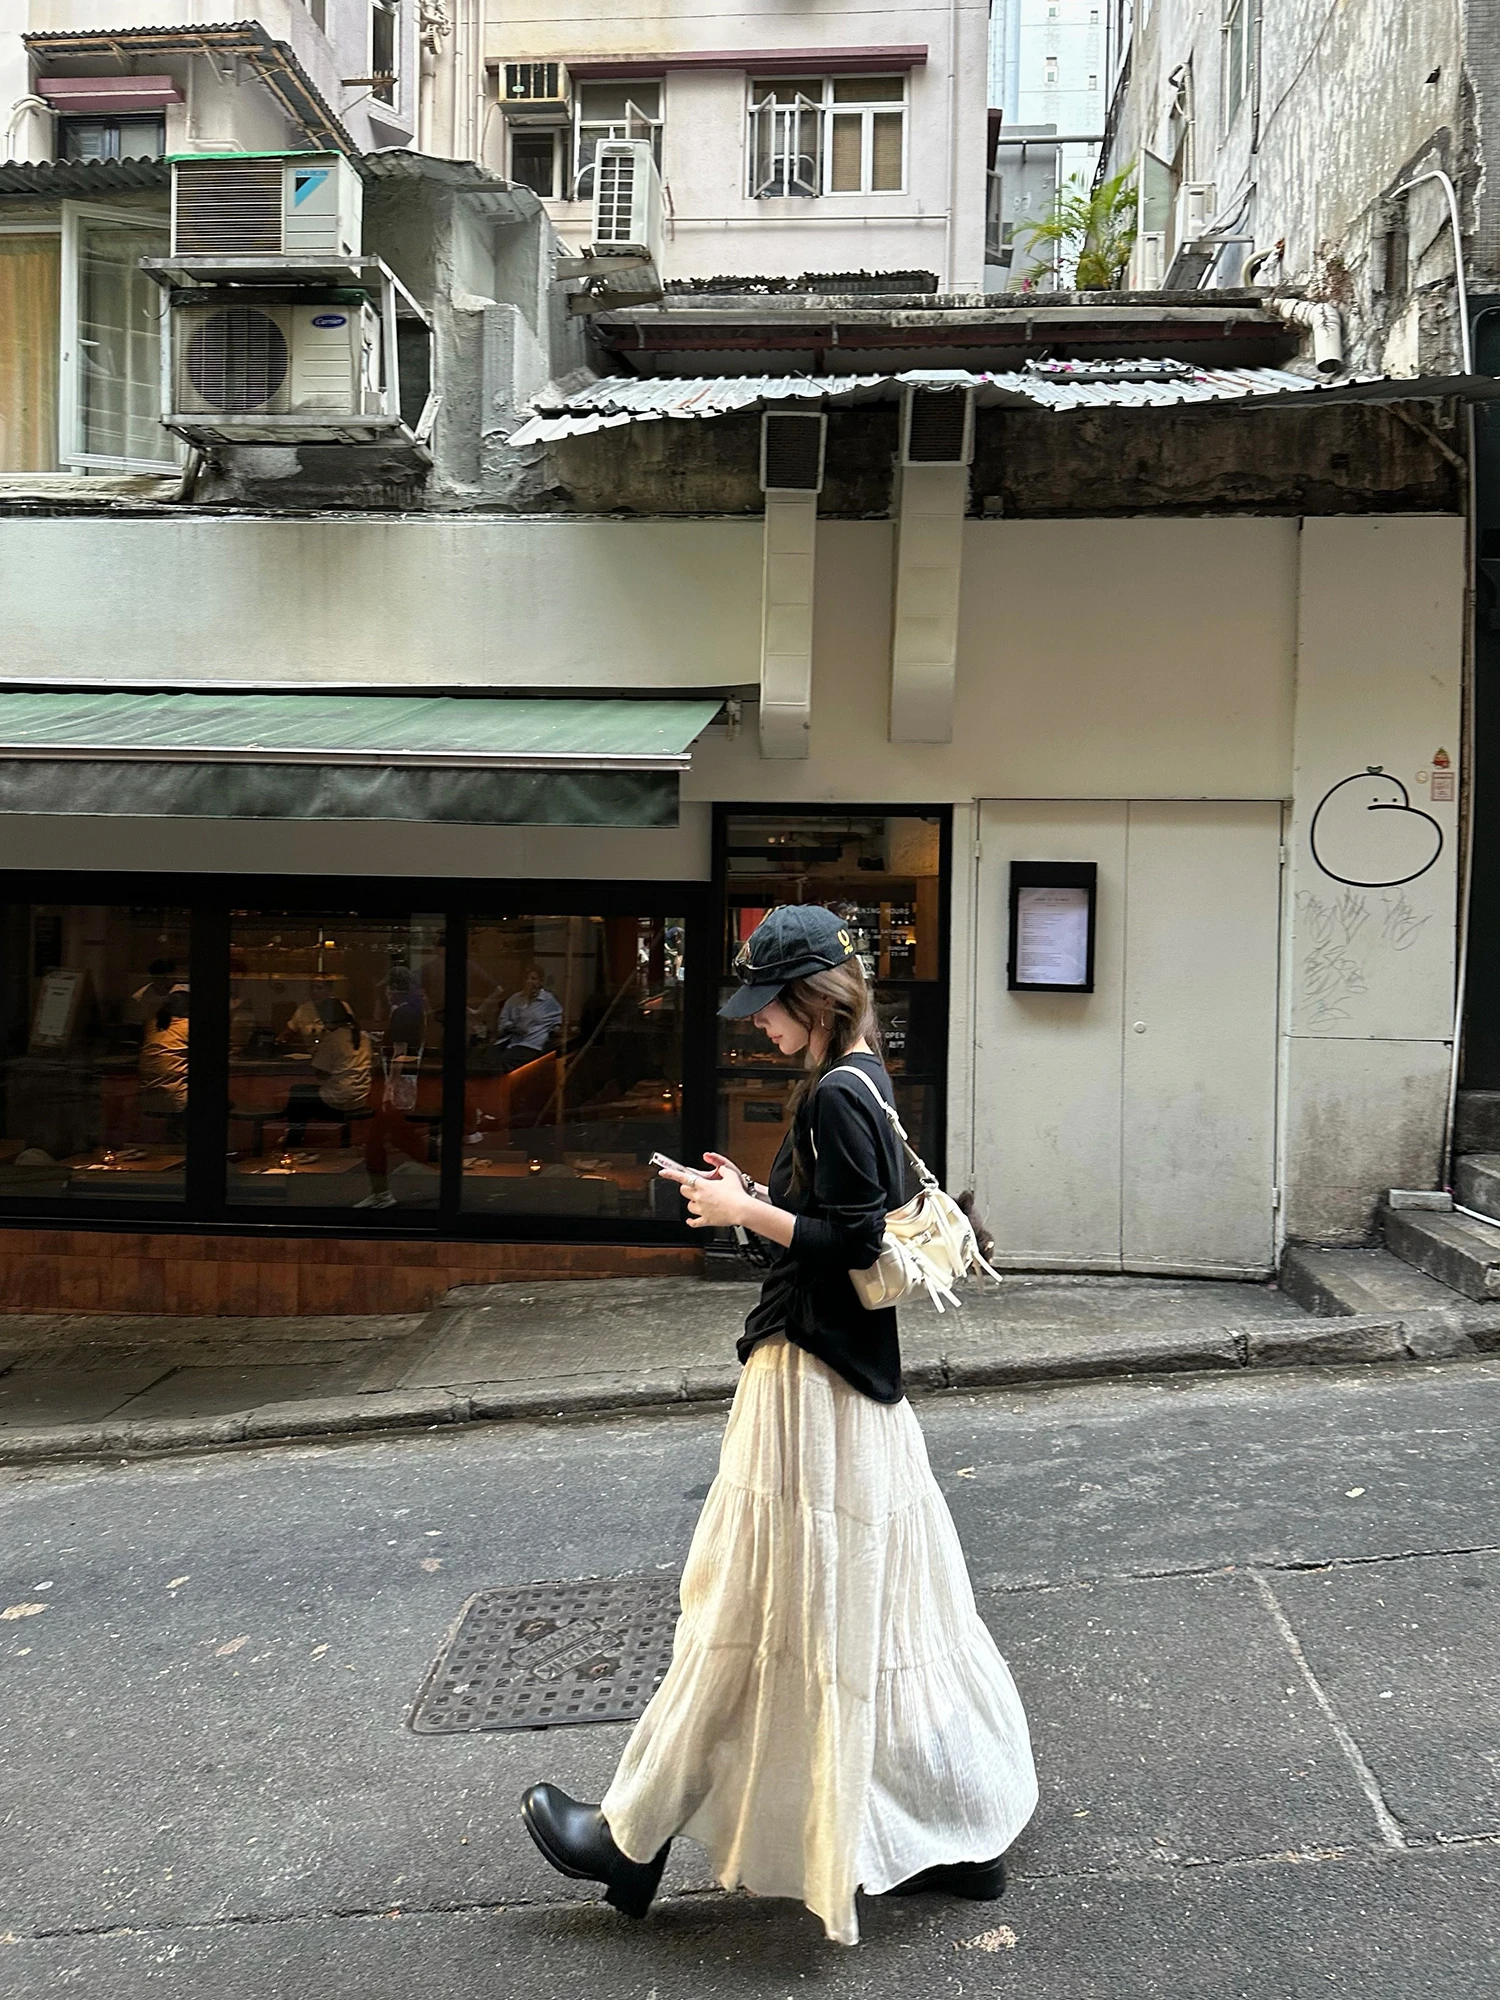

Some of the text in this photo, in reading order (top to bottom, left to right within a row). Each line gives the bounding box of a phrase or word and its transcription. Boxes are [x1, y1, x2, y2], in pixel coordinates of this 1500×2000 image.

[314, 317, 344, 326] Carrier
[885, 907, 910, 915] HOURS
[884, 1031, 906, 1039] OPEN
